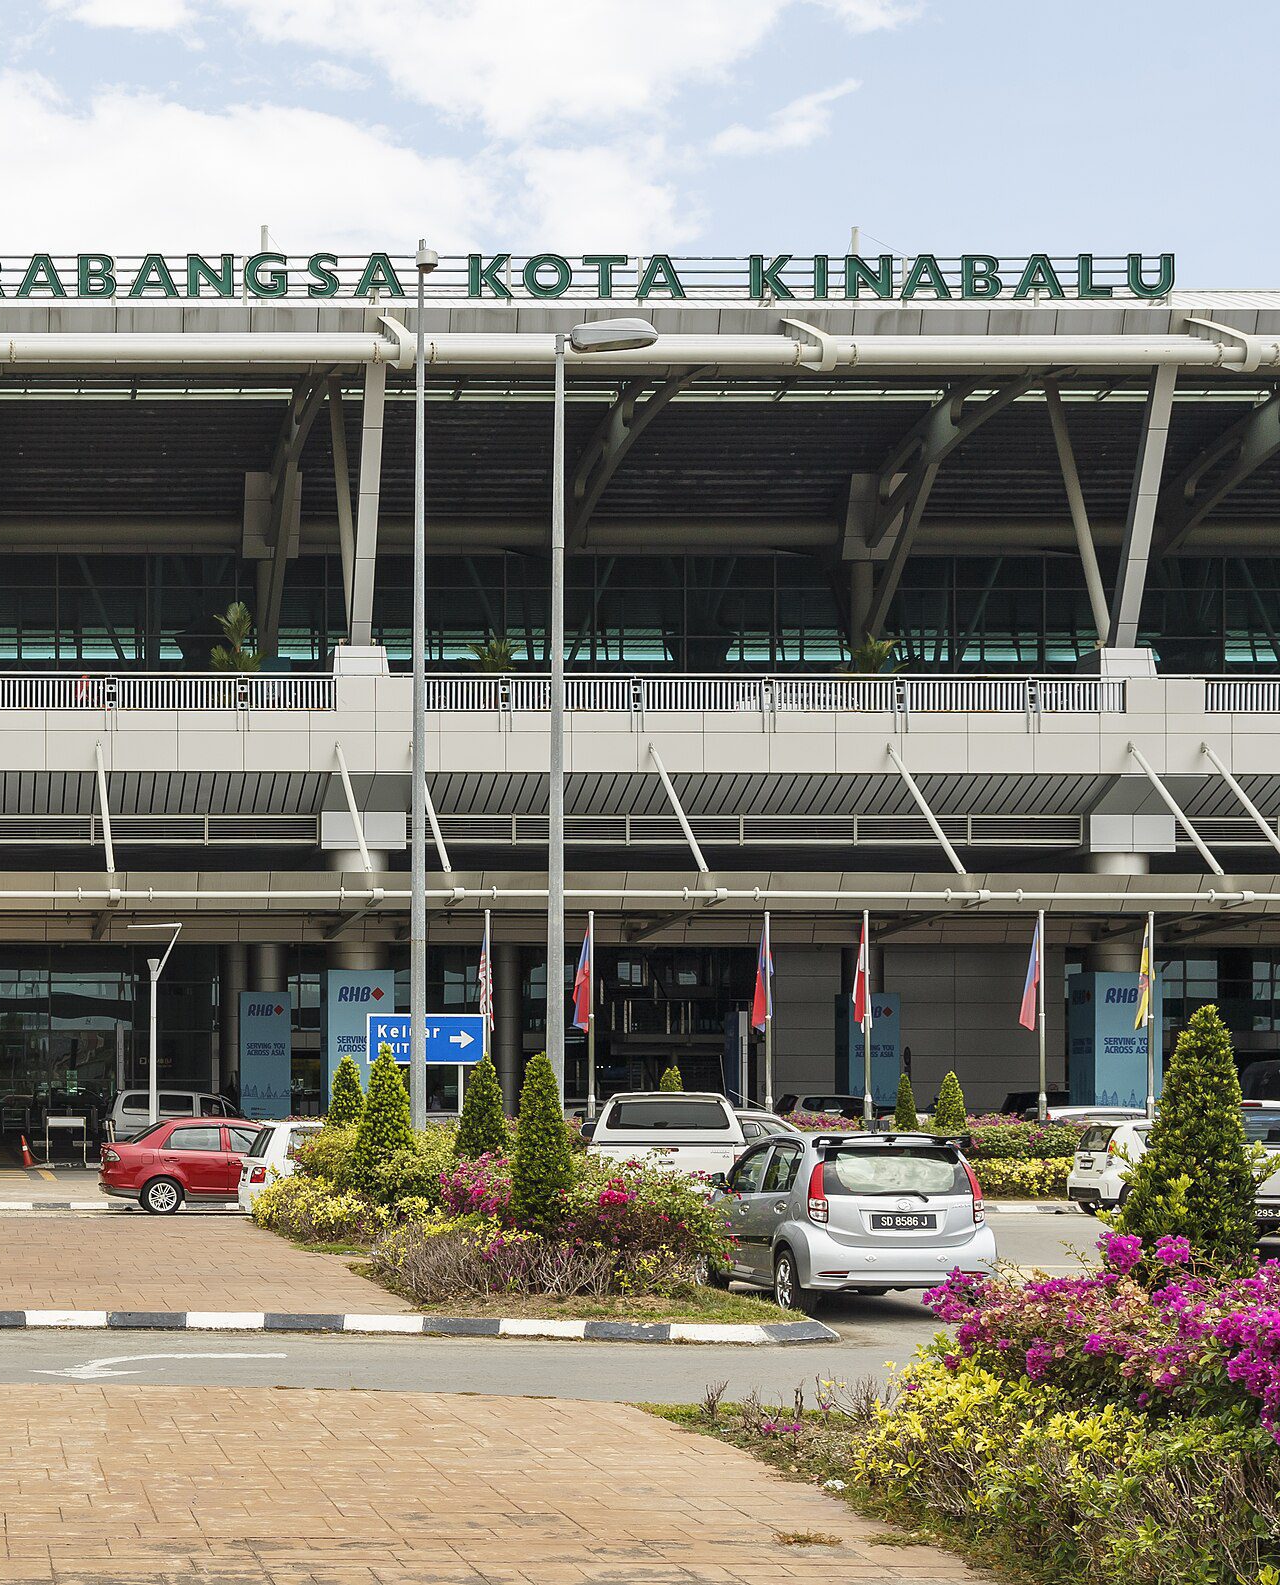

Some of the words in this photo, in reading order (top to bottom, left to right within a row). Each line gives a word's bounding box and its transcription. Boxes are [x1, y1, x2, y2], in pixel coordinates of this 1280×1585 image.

[467, 253, 687, 298] KOTA
[749, 253, 1176, 299] KINABALU
[338, 986, 371, 1002] RHB
[1105, 988, 1138, 1004] RHB
[248, 1004, 273, 1017] RHB
[377, 1025, 440, 1038] Kelar
[1104, 1037, 1136, 1045] SERVING
[1138, 1037, 1148, 1045] YO
[337, 1044, 366, 1052] ACROSS
[1105, 1046, 1133, 1054] ACROSS
[881, 1216, 893, 1226] SD
[895, 1216, 919, 1226] 8586
[921, 1216, 928, 1226] J
